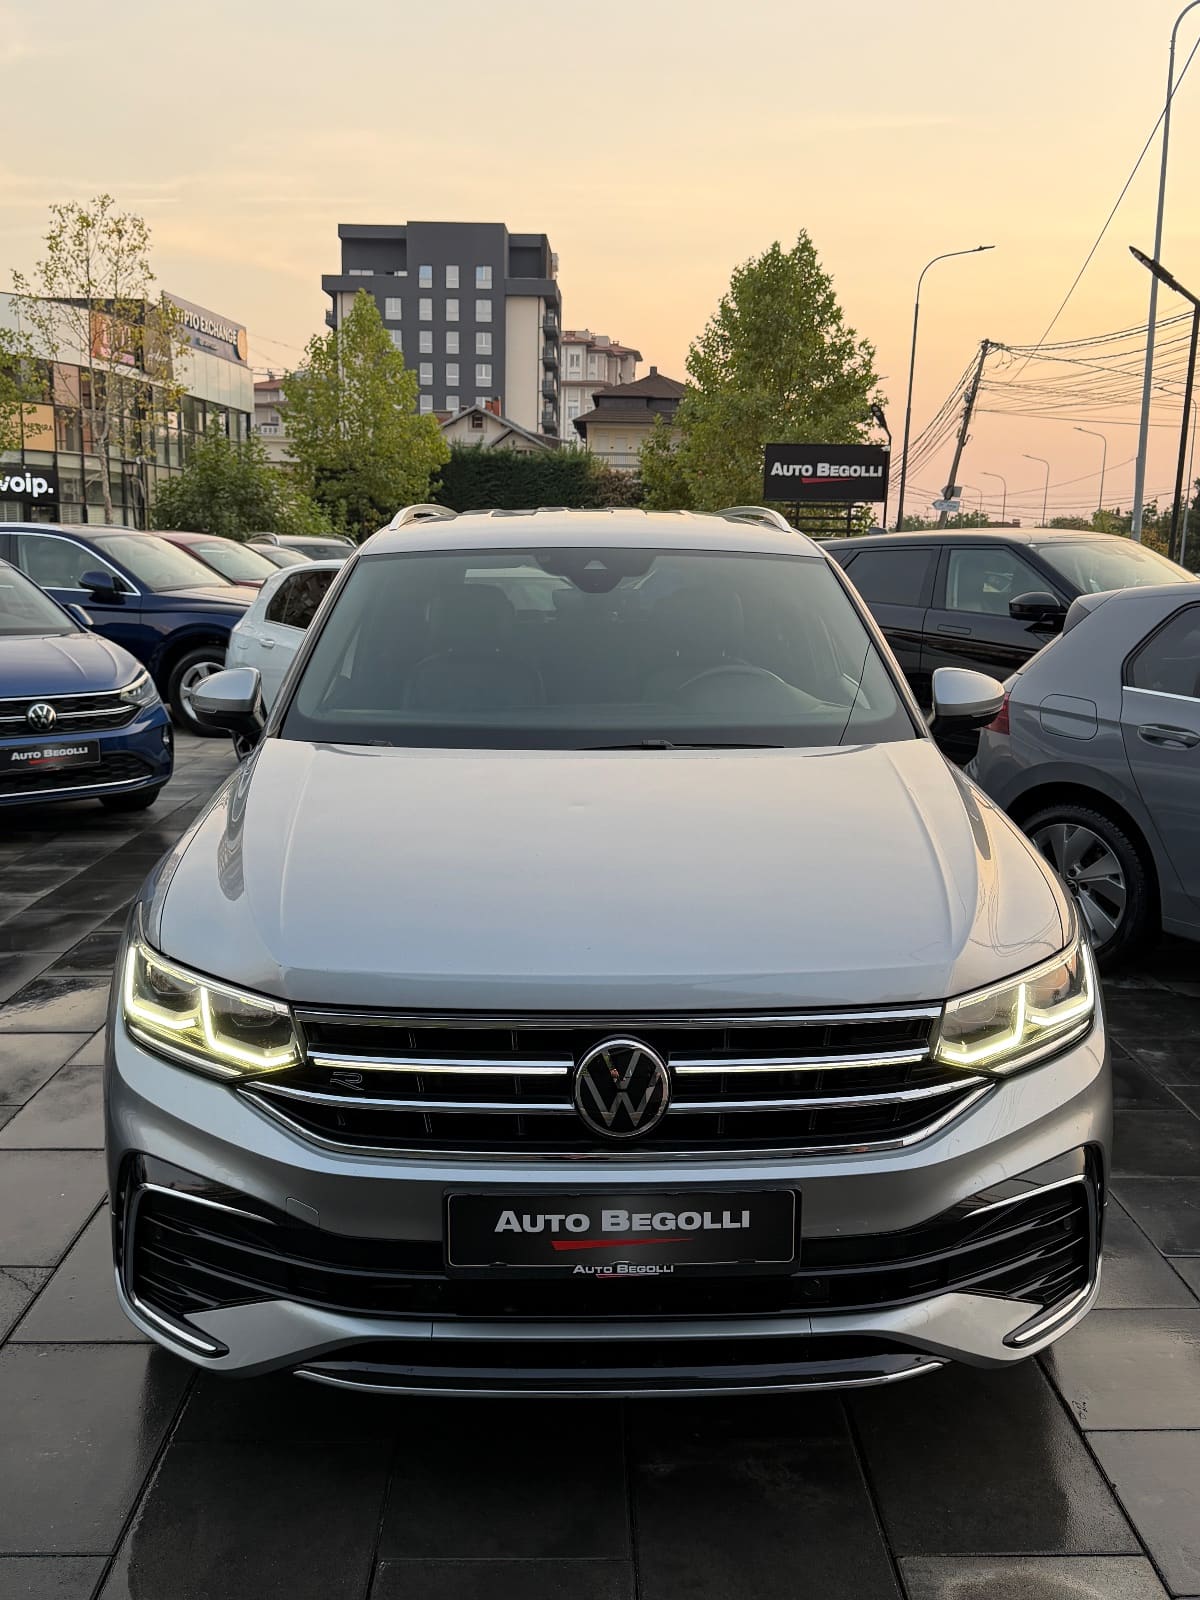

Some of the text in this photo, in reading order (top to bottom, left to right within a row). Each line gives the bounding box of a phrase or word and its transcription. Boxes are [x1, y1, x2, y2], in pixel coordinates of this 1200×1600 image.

[200, 316, 238, 346] EXCHANGE
[770, 462, 883, 478] AUTO BEGOLLI
[11, 746, 89, 761] AUTO BEGOLLI
[494, 1209, 751, 1233] AUTO BEGOLLI
[573, 1264, 675, 1275] AUTO BEGOLLI
